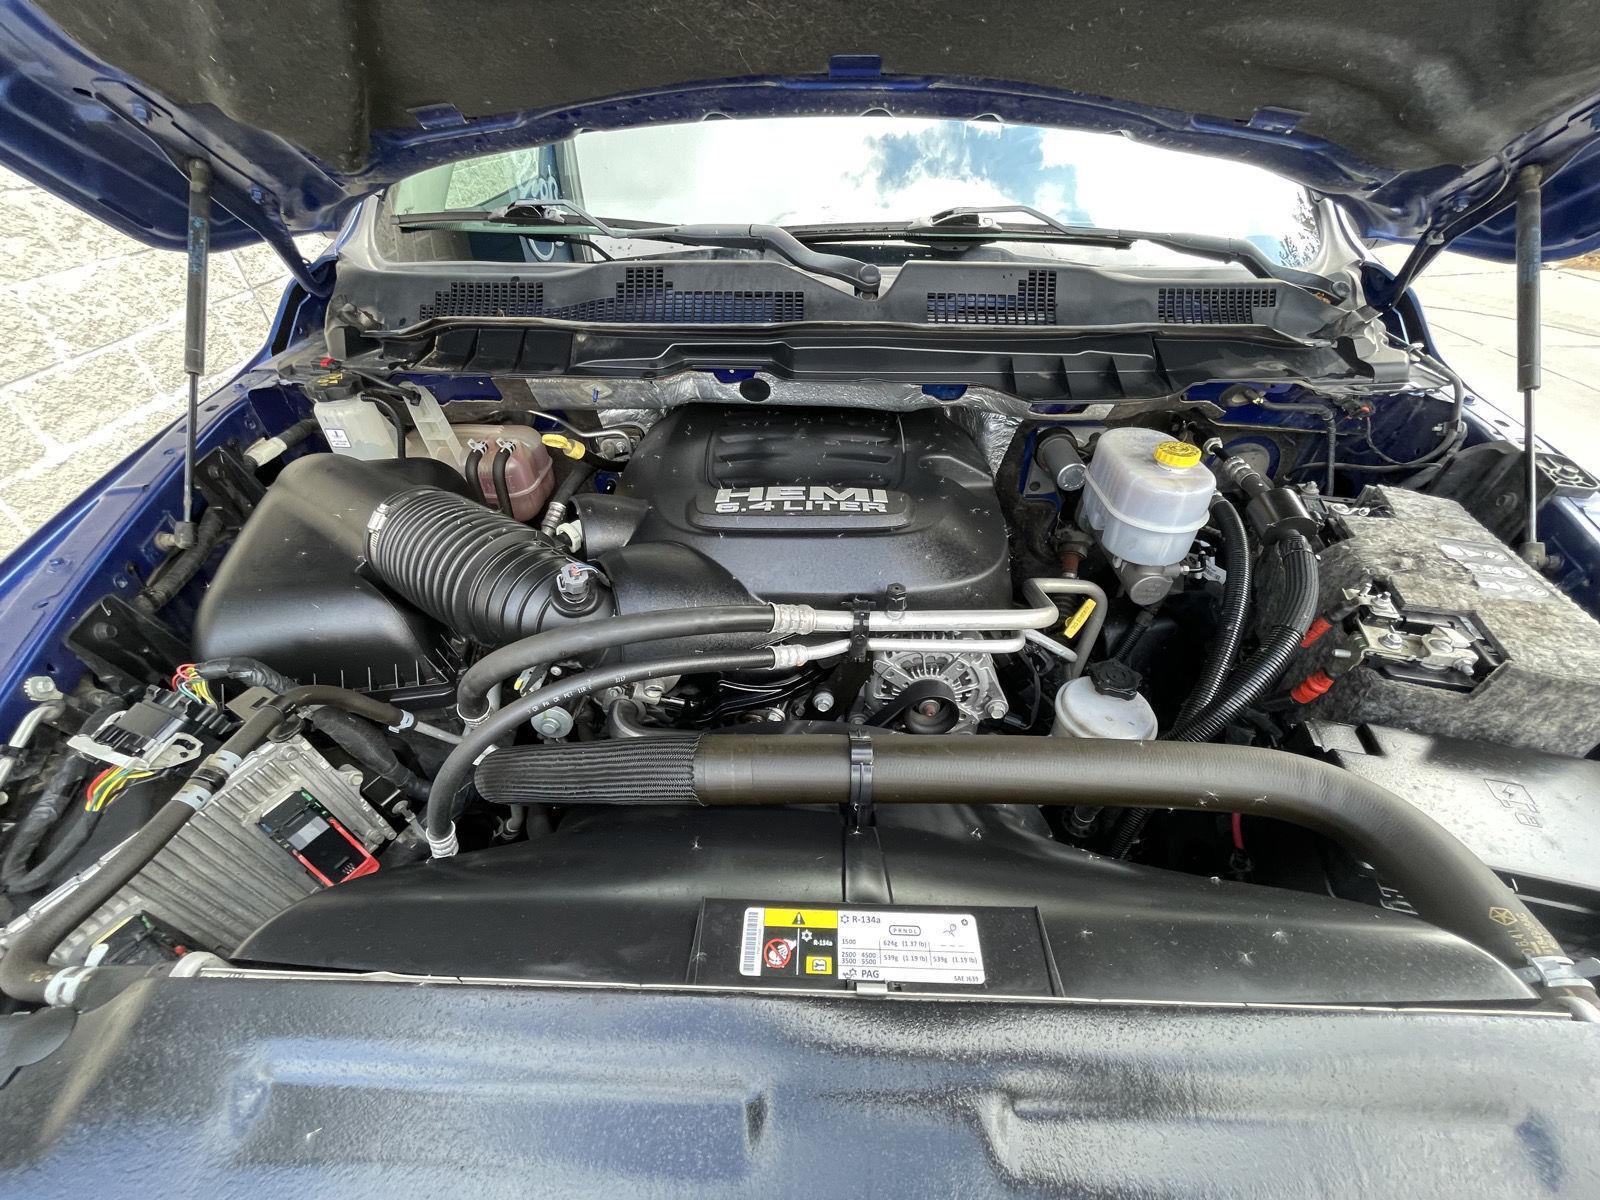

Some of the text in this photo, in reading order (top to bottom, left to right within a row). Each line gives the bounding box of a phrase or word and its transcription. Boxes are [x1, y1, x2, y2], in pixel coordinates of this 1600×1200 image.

[714, 486, 889, 503] HEMI
[715, 500, 888, 513] 6.4 LITER
[852, 915, 881, 924] R-134a
[861, 969, 880, 979] PAG
